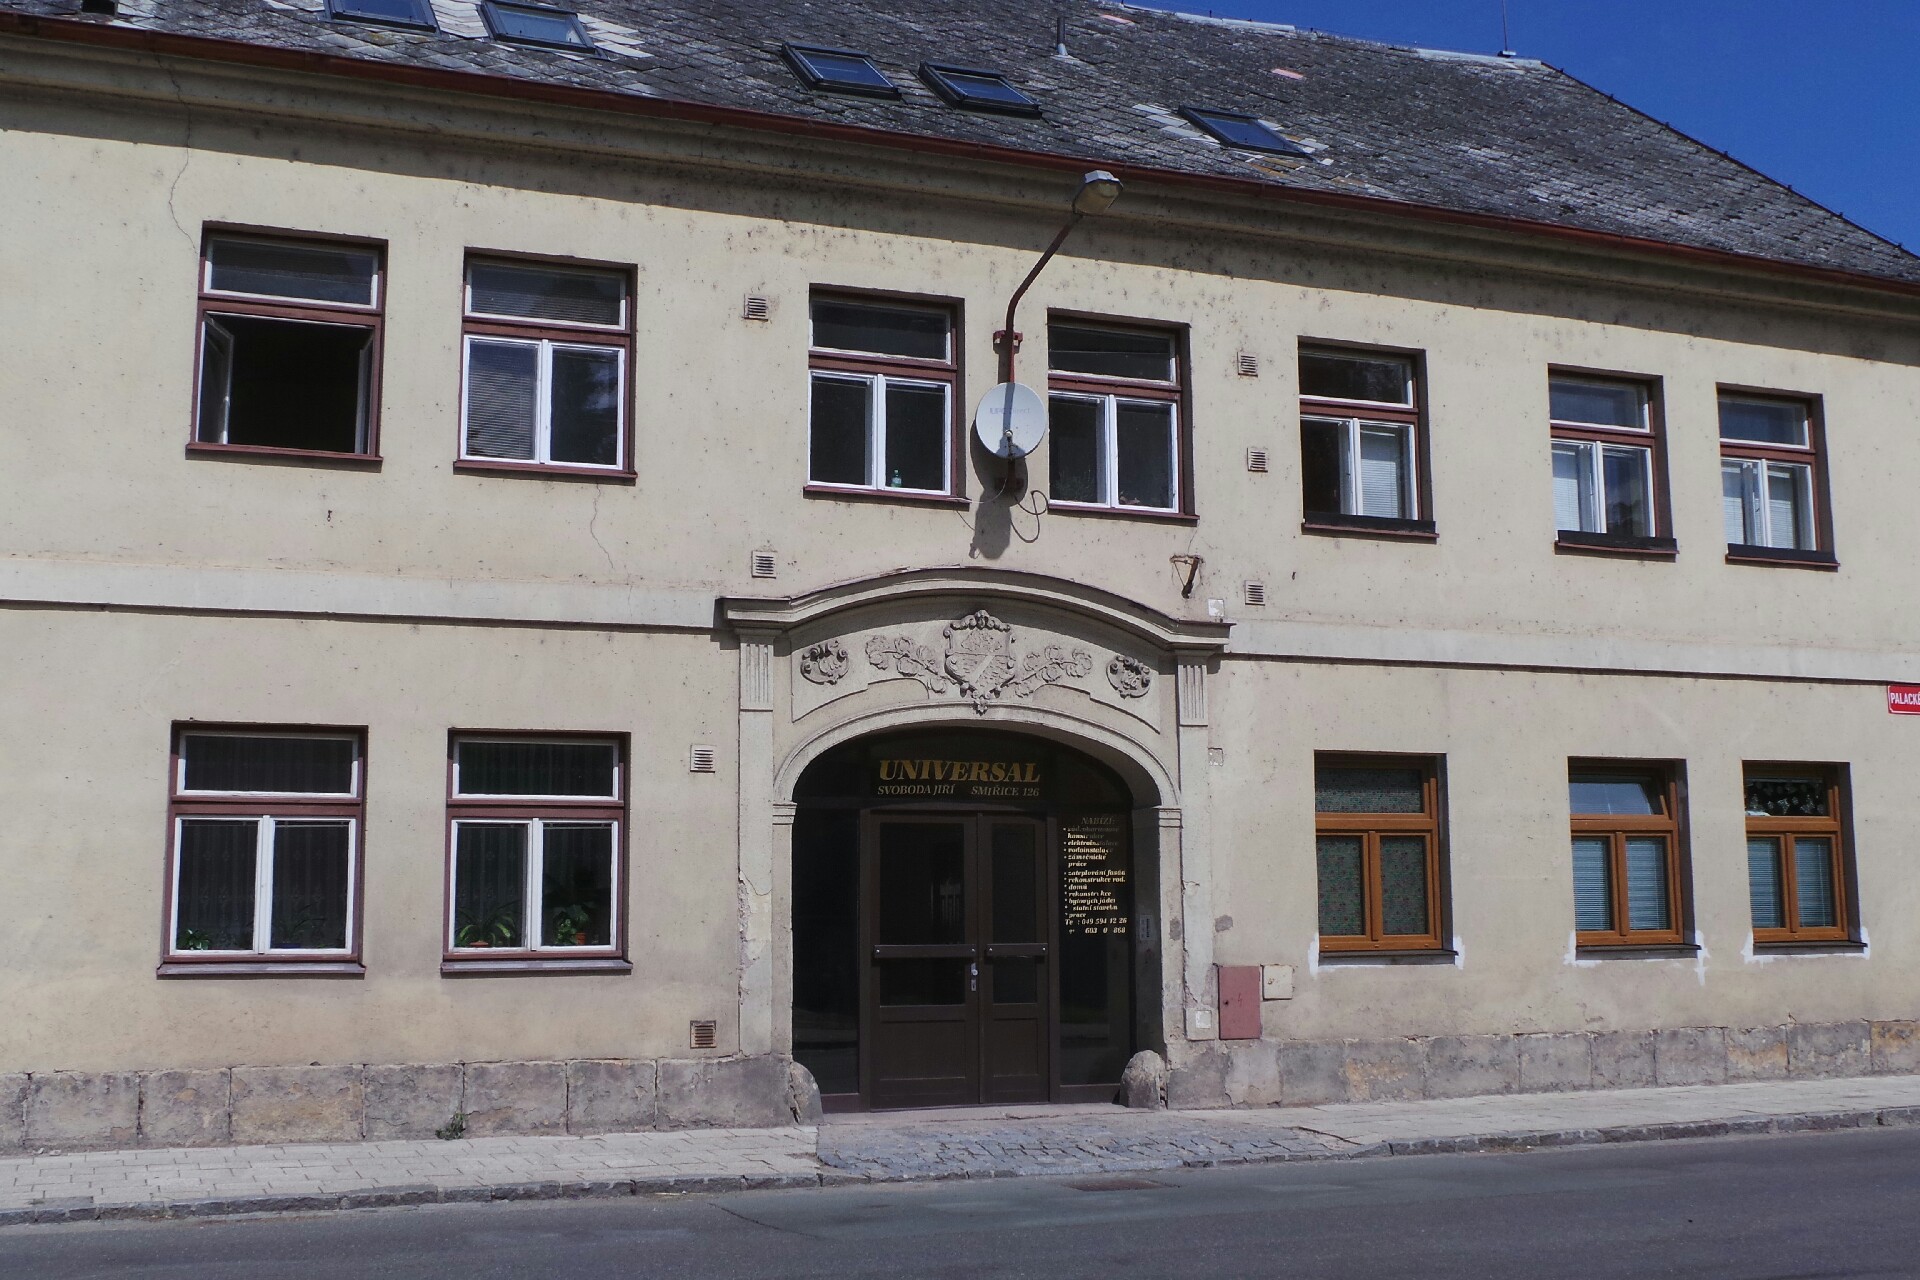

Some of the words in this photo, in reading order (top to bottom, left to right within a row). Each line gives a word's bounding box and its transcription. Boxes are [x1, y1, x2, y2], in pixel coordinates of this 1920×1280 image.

[879, 759, 1041, 783] UNIVERSAL
[878, 784, 931, 796] SVOBODA
[932, 783, 956, 796] JIŘÍ
[971, 784, 1019, 797] SMIŘICE
[1023, 787, 1040, 797] 126
